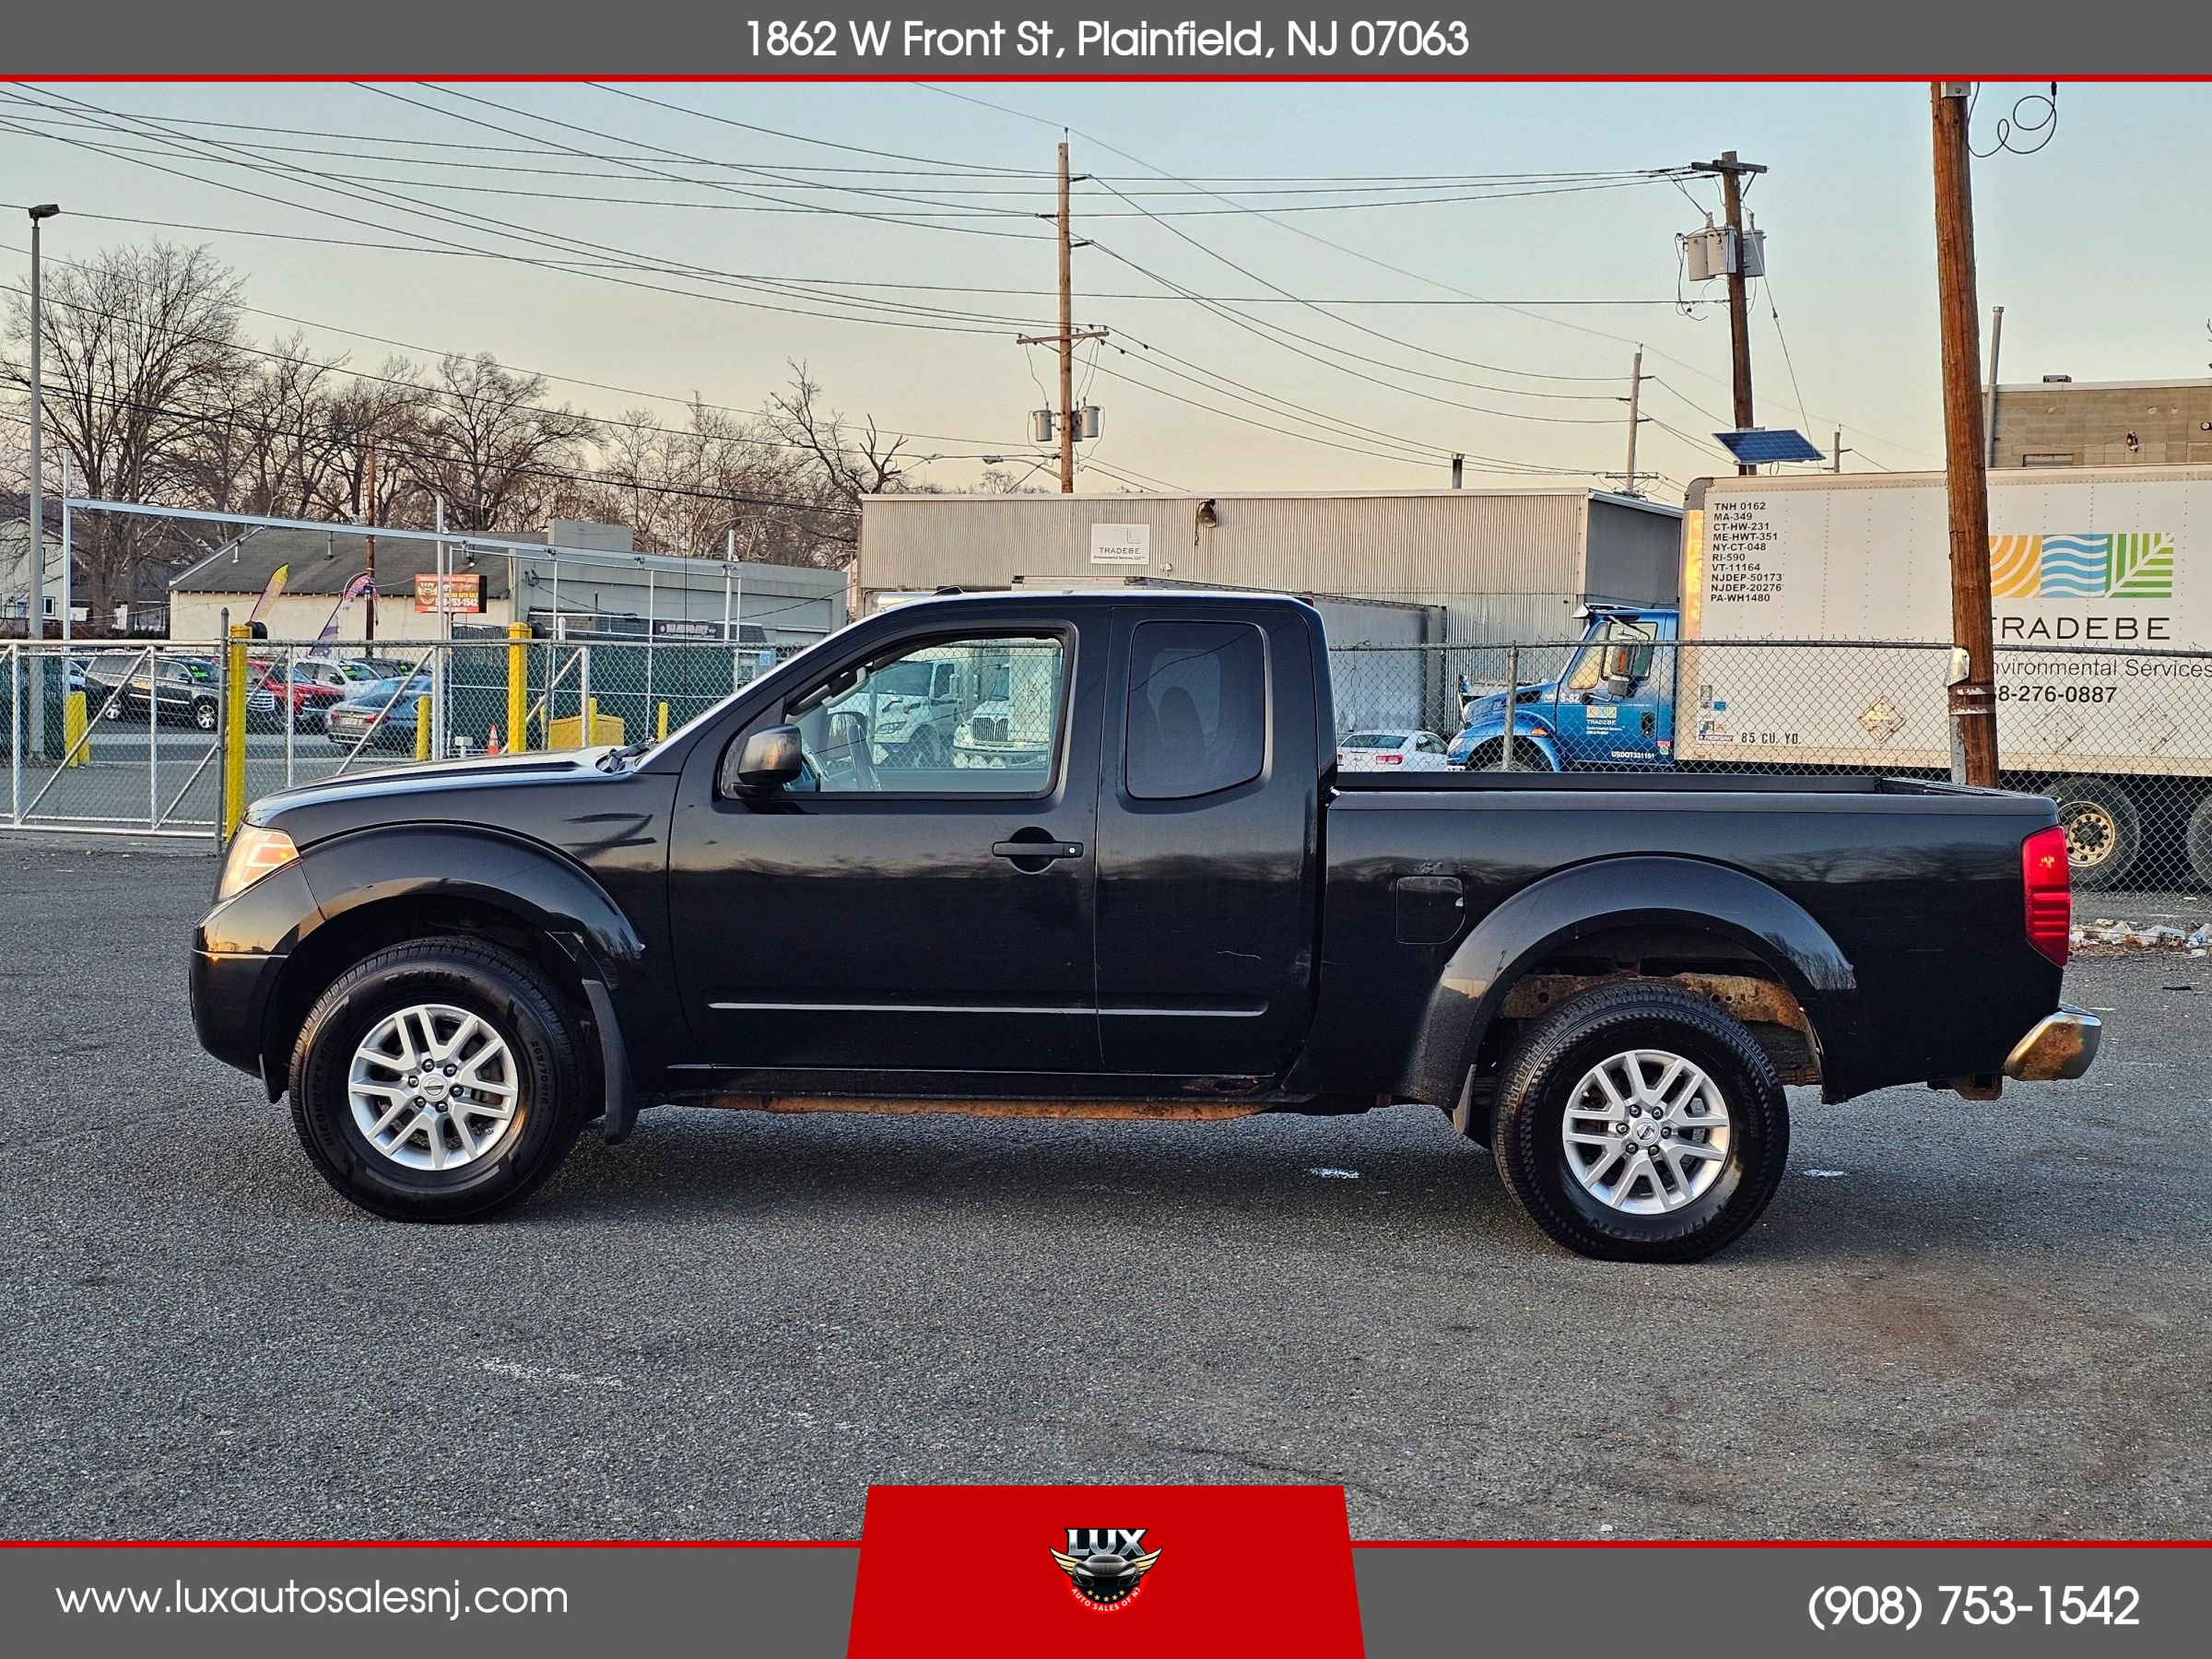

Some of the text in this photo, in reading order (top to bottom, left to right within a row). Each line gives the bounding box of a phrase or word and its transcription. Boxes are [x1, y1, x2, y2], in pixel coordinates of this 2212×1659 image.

[1714, 502, 1766, 511] TNH 0162
[1713, 512, 1753, 521] MA-349
[1713, 523, 1770, 531] CT-HW-231
[1713, 533, 1778, 541] ME-HWT-351
[1099, 547, 1141, 555] TRADEBE
[1712, 543, 1767, 551] NY-CT-048
[1712, 553, 1746, 561] RI-590
[1712, 563, 1760, 571] VT-11164
[1711, 573, 1783, 582] NJDEP-50173
[1711, 583, 1782, 592] NJDEP-20276
[1711, 594, 1771, 602] PA-WH1480
[1992, 617, 2171, 641] RADEBE
[1994, 658, 2212, 678] nvironmental Services
[1560, 693, 1580, 703] S-82
[1995, 686, 2117, 702] 8-276-0887
[1741, 732, 1756, 744] 85
